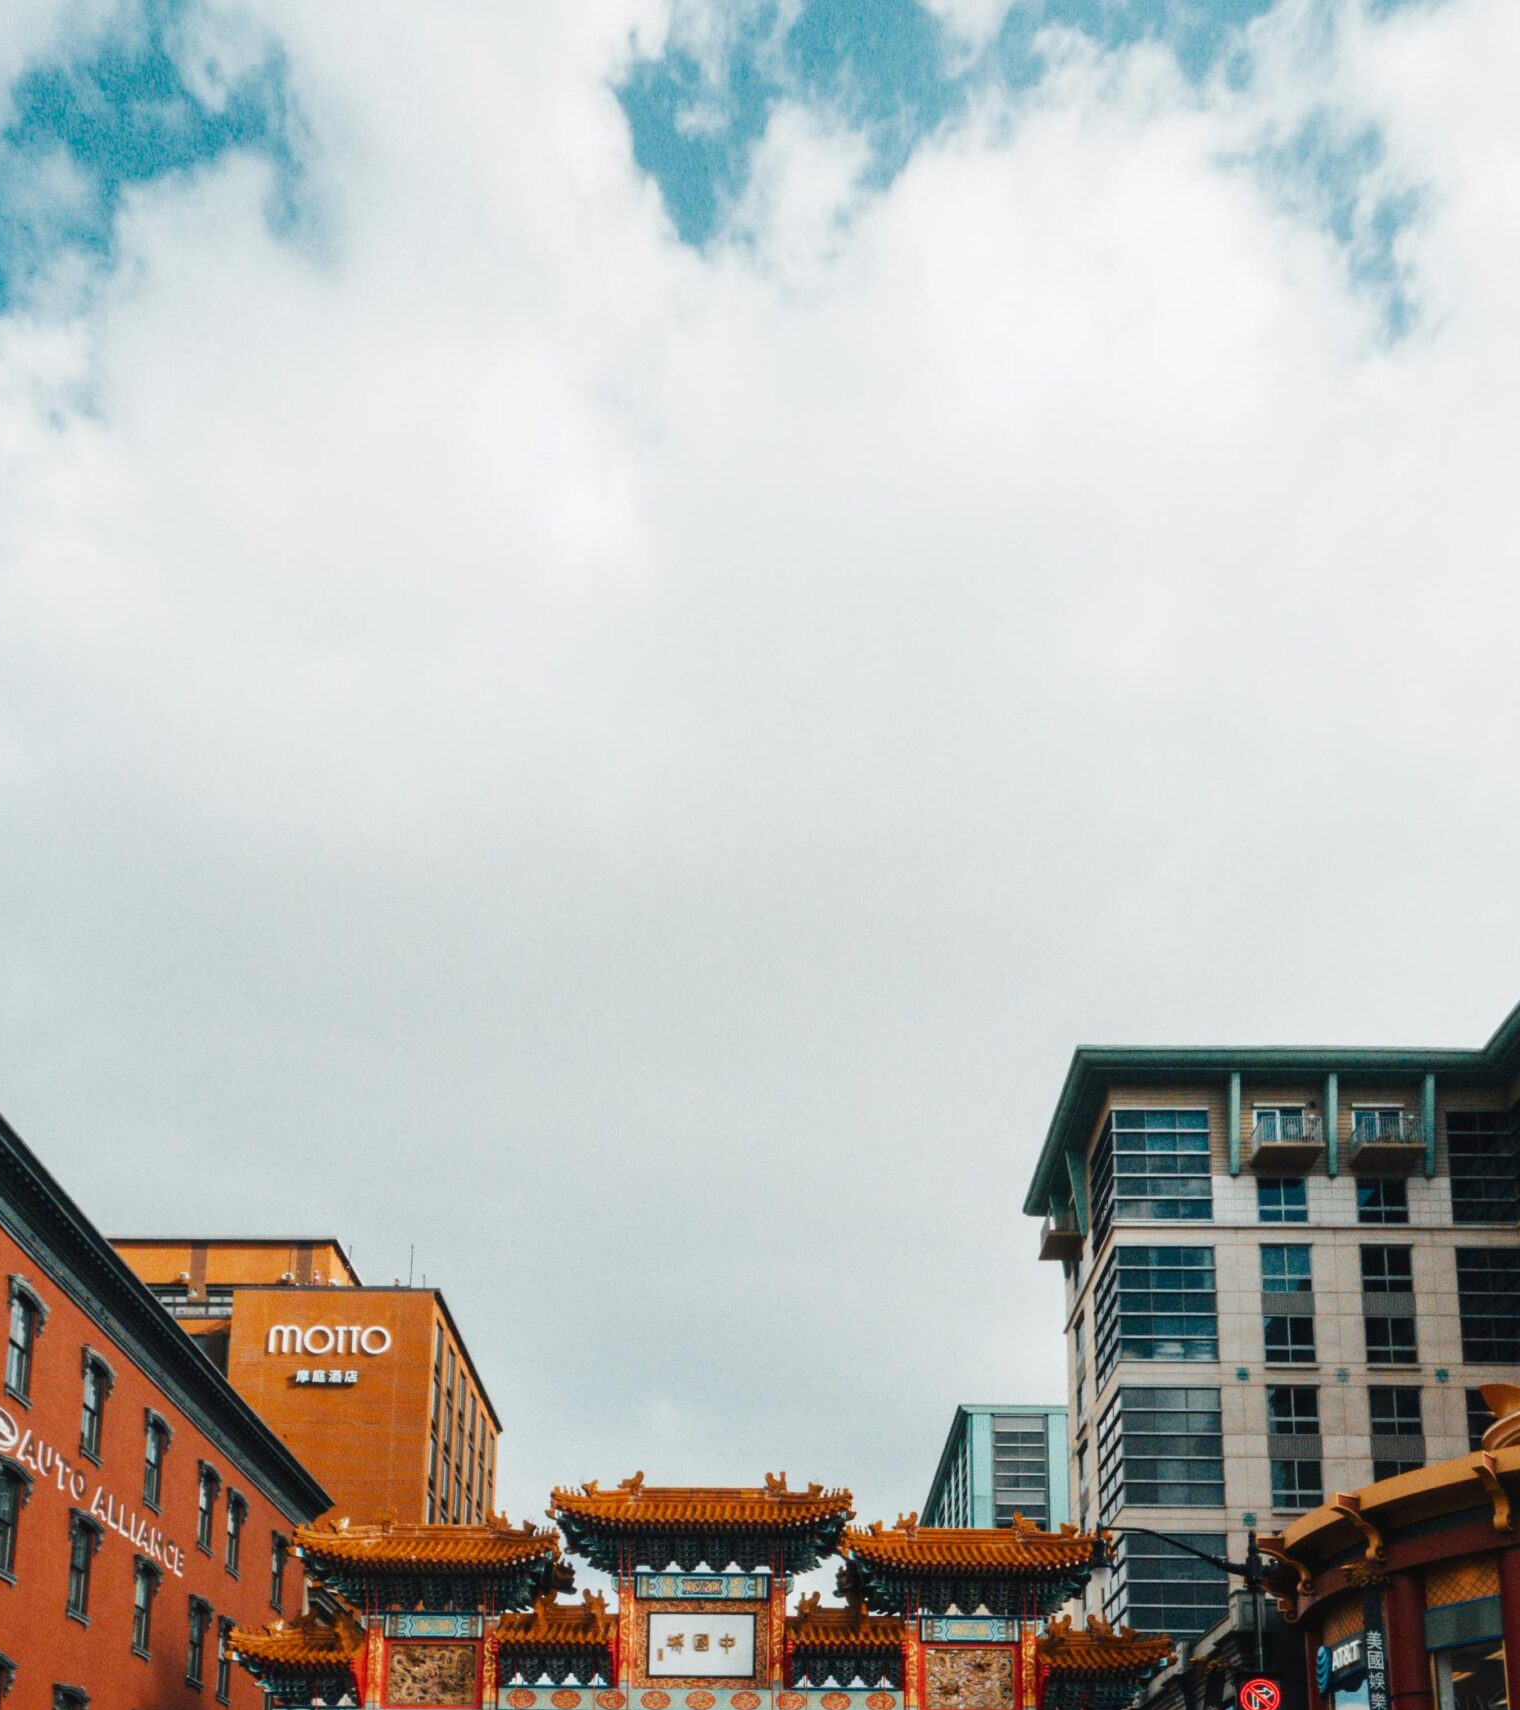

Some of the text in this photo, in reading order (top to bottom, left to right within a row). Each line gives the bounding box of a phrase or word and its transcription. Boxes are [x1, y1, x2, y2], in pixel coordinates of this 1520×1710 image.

[268, 1325, 392, 1355] MOTTO
[295, 1369, 358, 1383] 摩庭酒店
[16, 1429, 185, 1578] AUTO ALLIANCE
[1331, 1640, 1362, 1672] AT&T
